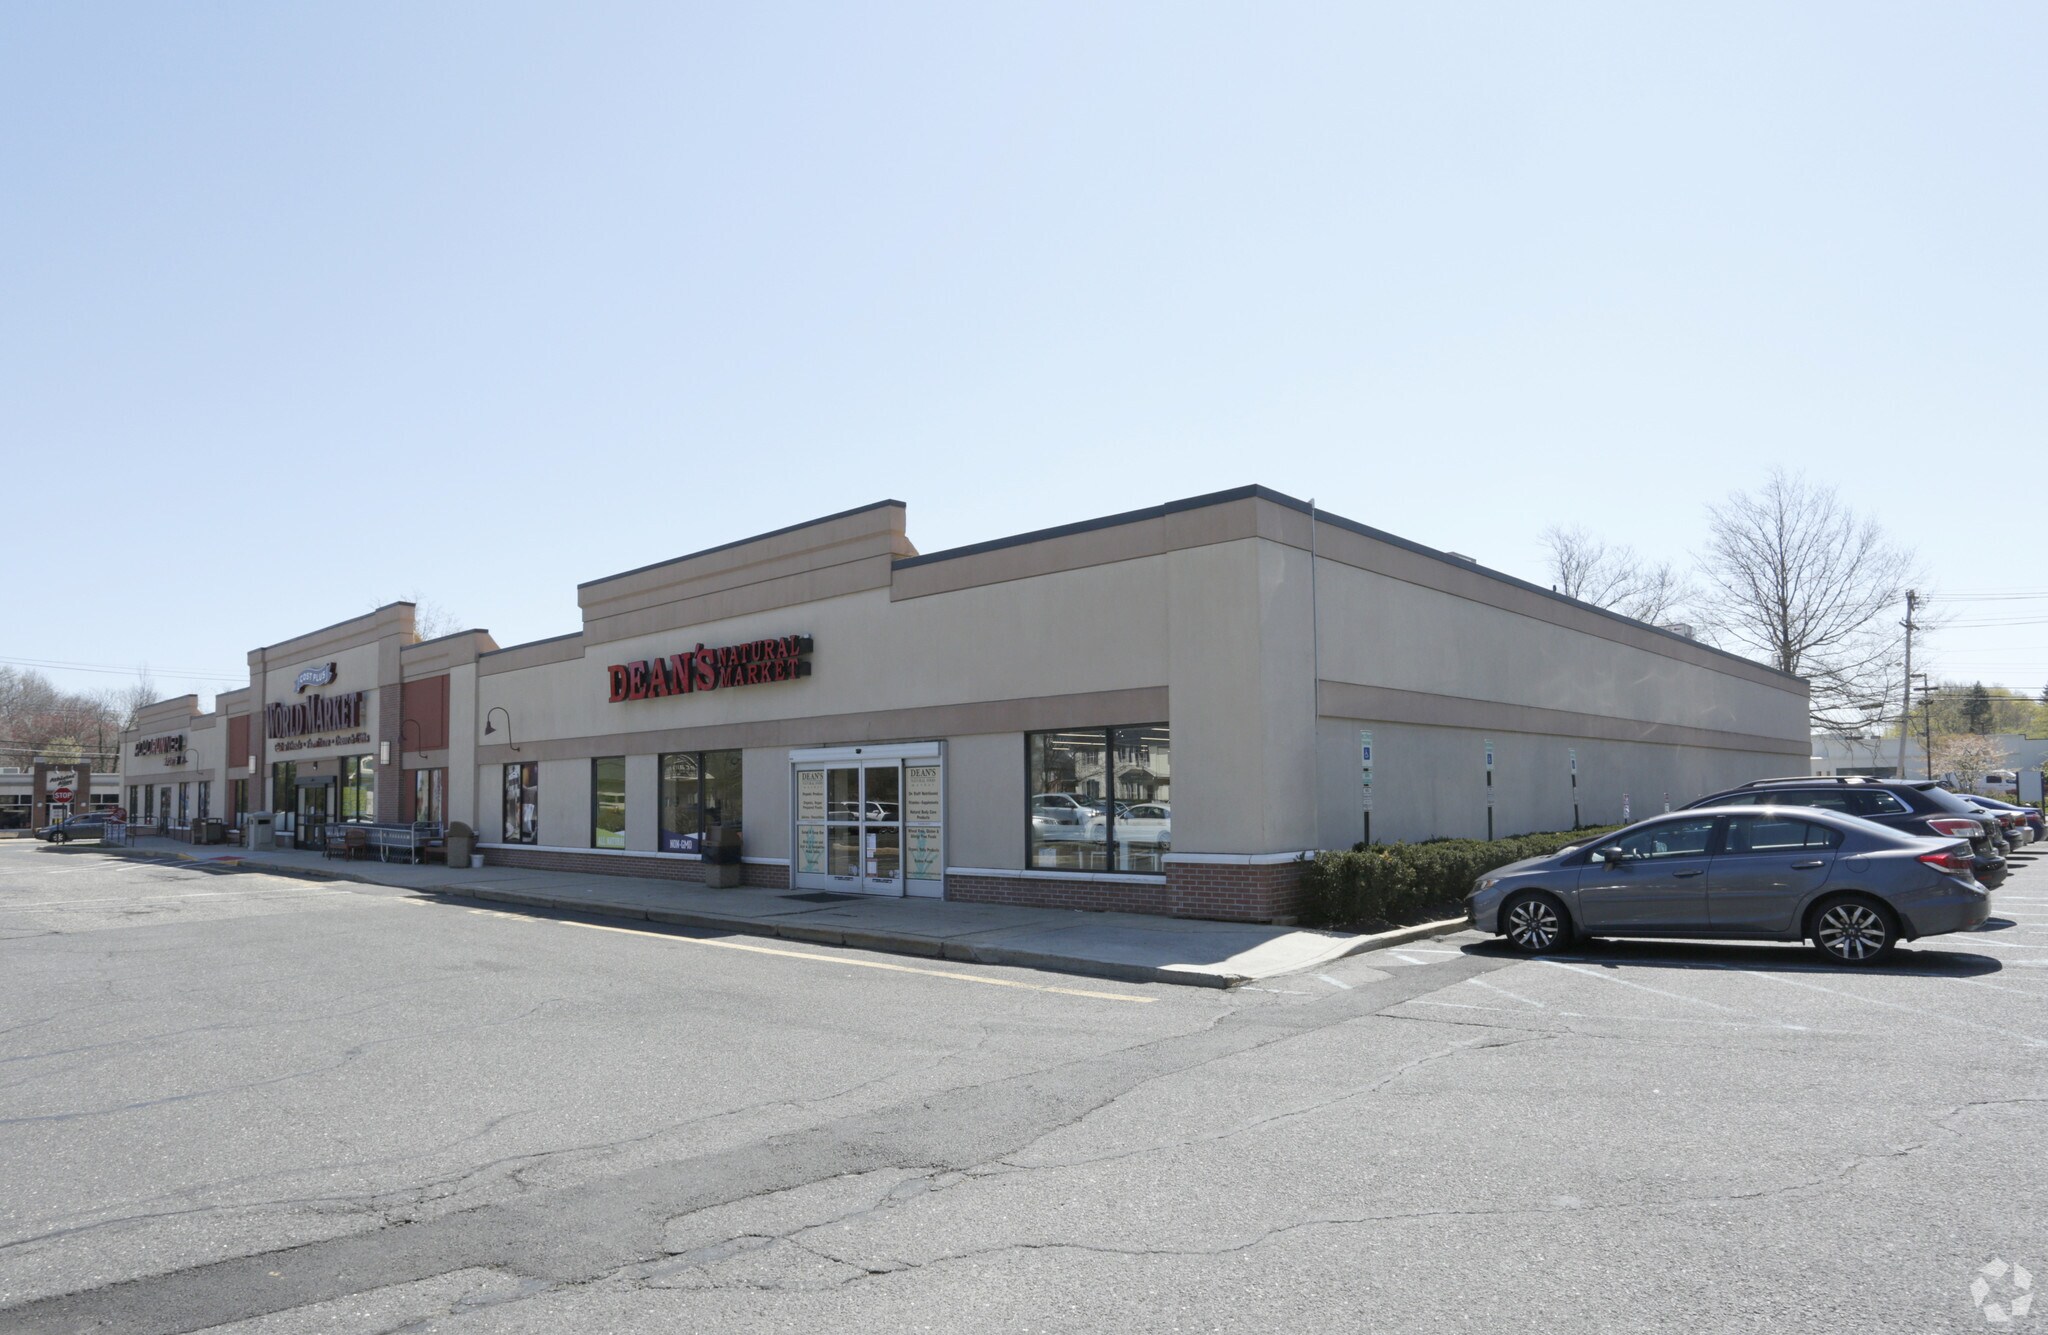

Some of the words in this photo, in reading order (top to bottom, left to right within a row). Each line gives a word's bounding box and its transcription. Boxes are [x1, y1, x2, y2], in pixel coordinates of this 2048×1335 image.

[607, 642, 718, 703] DEAN'S
[717, 634, 801, 667] NATURAL
[719, 657, 800, 688] MARKET
[300, 672, 313, 683] COST
[313, 670, 326, 682] PLUS
[266, 702, 306, 739] WORLD
[306, 693, 360, 735] MARKET
[802, 772, 824, 780] DEAN'S
[910, 768, 937, 777] DEAN'S
[54, 791, 73, 799] STOP
[669, 839, 693, 850] NON-GMO
